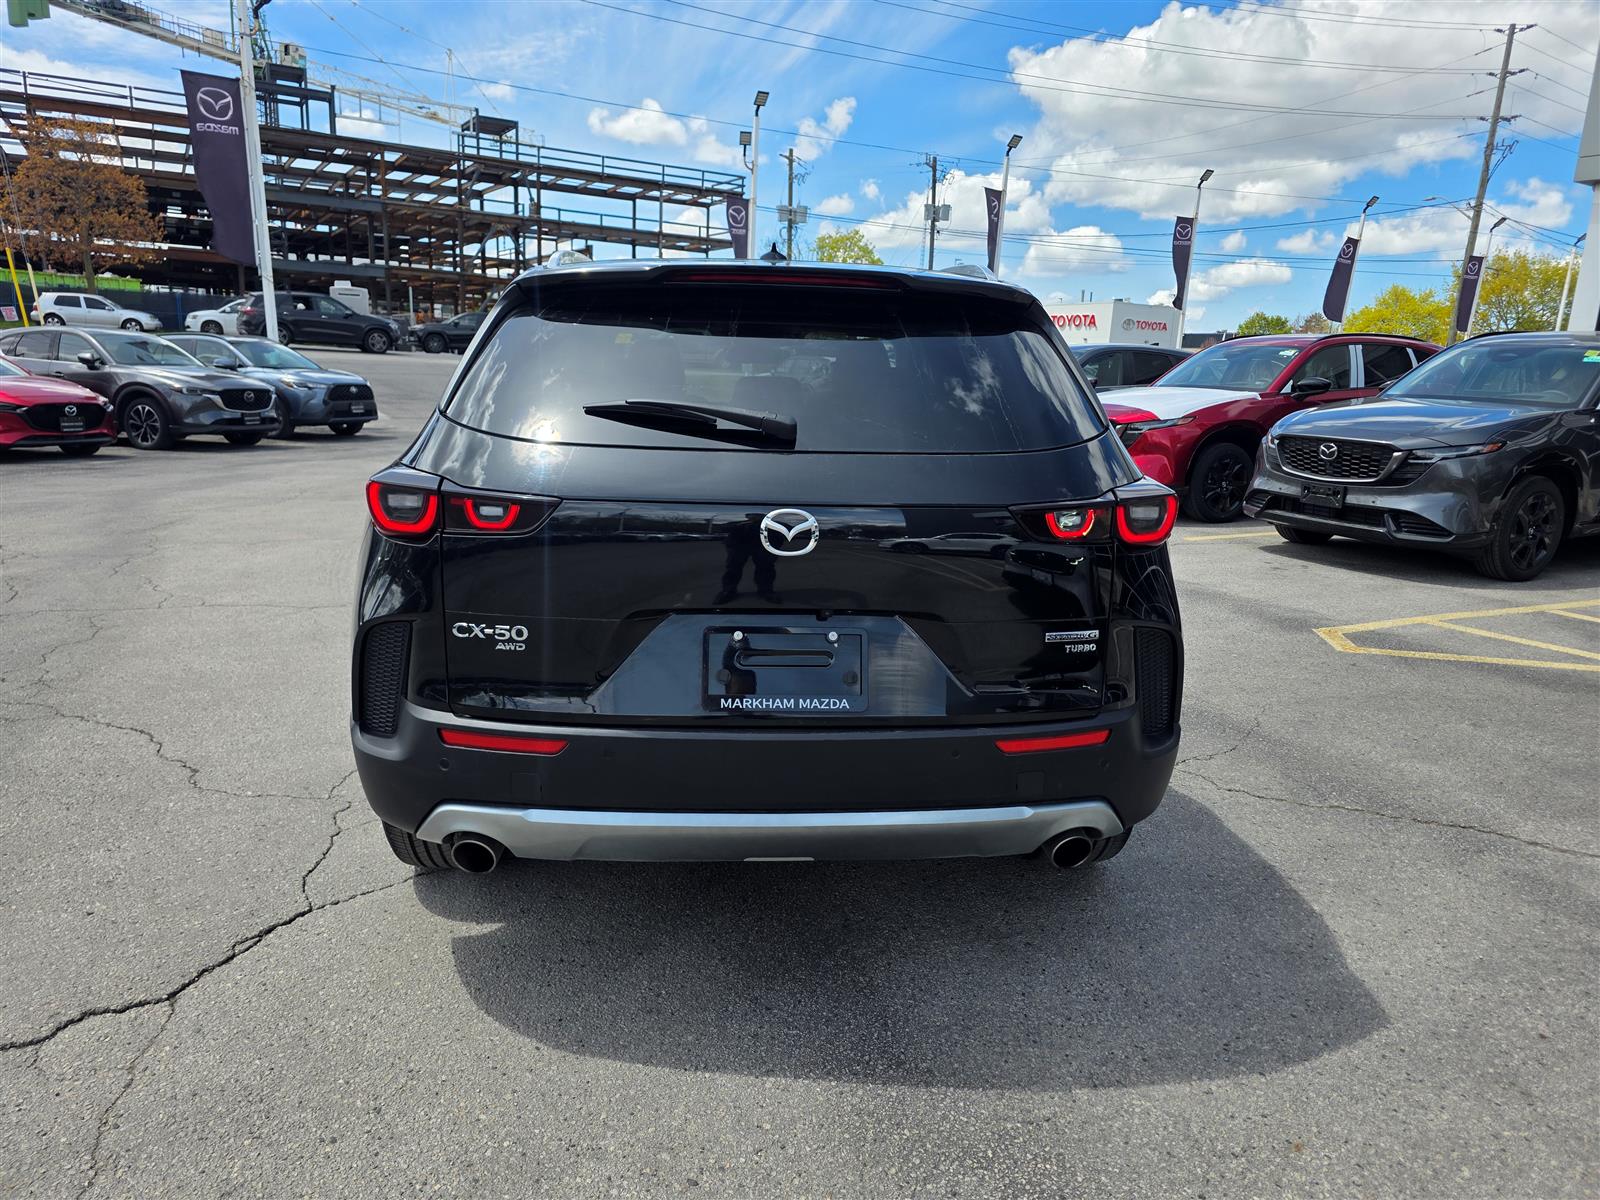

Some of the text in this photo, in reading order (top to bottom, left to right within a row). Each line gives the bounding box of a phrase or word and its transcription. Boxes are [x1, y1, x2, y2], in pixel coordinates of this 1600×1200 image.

[1051, 314, 1097, 328] TOYOTA
[1135, 319, 1168, 332] TOYOTA
[451, 621, 529, 641] CX-50
[495, 642, 526, 651] AWD
[1065, 643, 1097, 653] TURBO
[720, 698, 850, 709] MARKHAM MAZDA
